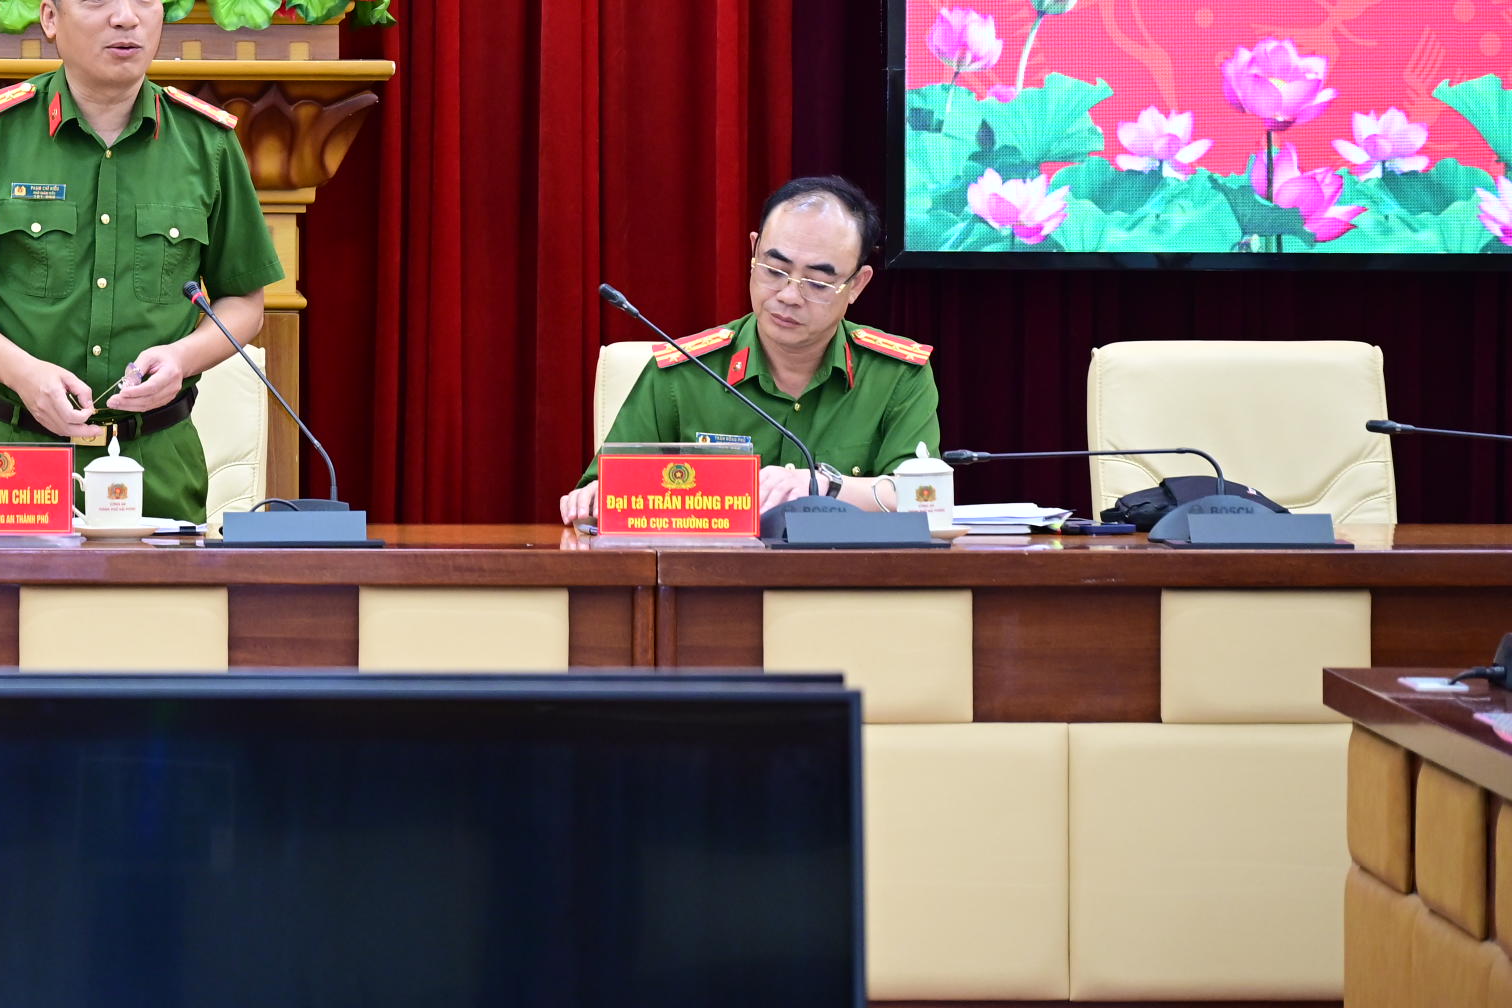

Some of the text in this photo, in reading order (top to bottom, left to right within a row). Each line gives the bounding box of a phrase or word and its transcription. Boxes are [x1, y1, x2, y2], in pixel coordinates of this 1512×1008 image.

[12, 486, 30, 504] CHÍ
[34, 485, 59, 504] HIẾU
[606, 490, 751, 512] Đại tá TRẦN HỒNG PHÚ
[6, 515, 15, 524] AN
[16, 513, 35, 524] THÀNH
[37, 512, 49, 524] PHỐ
[628, 515, 647, 528] PHÓ
[650, 518, 669, 530] CỤC
